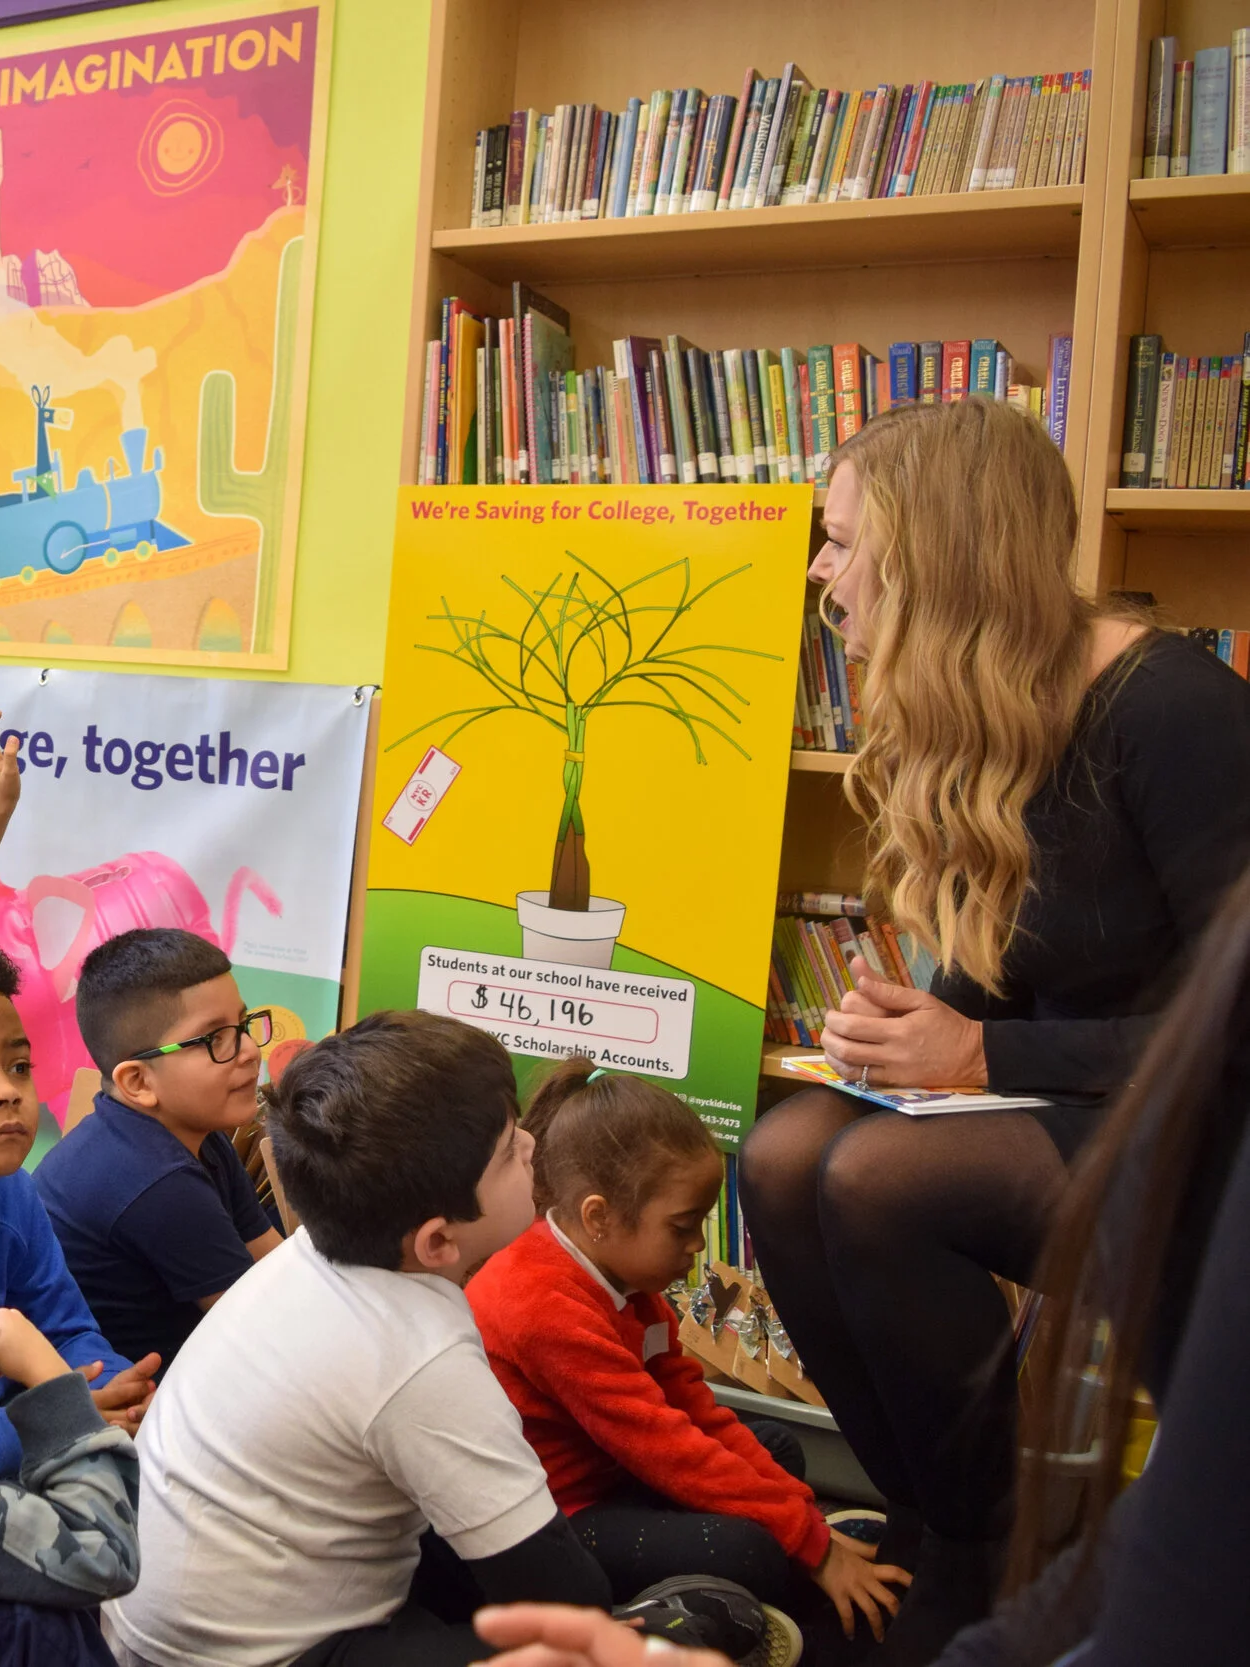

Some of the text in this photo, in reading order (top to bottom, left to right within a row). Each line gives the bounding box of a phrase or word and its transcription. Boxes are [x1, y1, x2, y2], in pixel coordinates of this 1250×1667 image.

[749, 113, 772, 174] VANISHING
[923, 356, 935, 389] CHARLIE
[950, 357, 963, 389] CHARLIE
[977, 356, 990, 389] CHARLIE
[1054, 377, 1067, 418] LITTLE
[411, 500, 788, 526] We're Saving for College, Together
[83, 724, 305, 792] together
[411, 784, 423, 800] NYC
[427, 955, 687, 1002] Students at our school have received
[514, 1035, 596, 1060] Scholarship
[601, 1049, 674, 1073] Accounts.
[688, 1096, 742, 1111] @nyckidsrise
